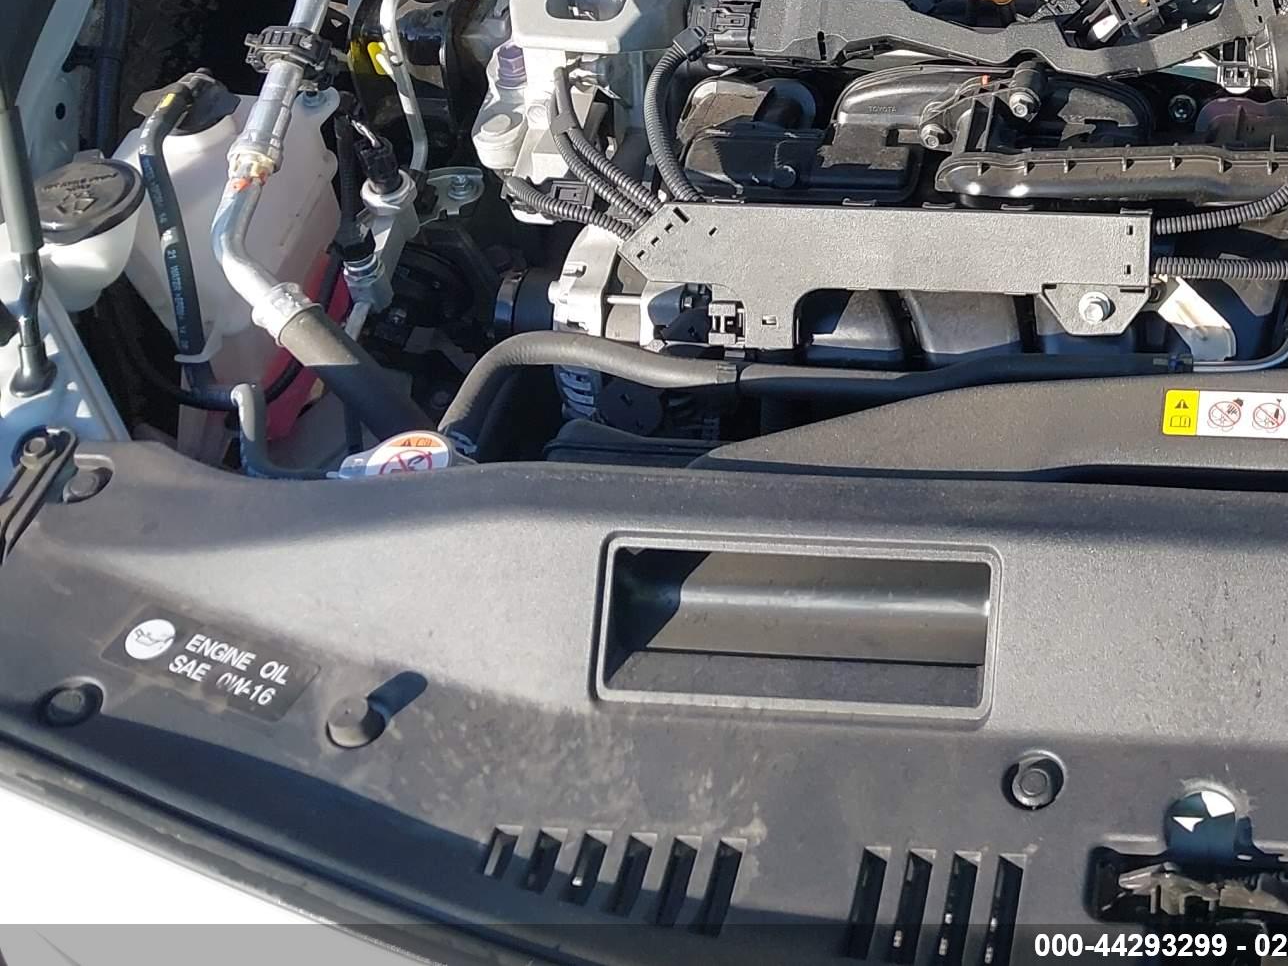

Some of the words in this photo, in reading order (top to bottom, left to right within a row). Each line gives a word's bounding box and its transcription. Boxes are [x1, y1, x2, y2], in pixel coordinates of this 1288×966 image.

[868, 105, 897, 113] TOYOTA
[169, 655, 211, 682] SAE
[185, 634, 256, 671] ENGINE
[259, 661, 289, 685] OIL
